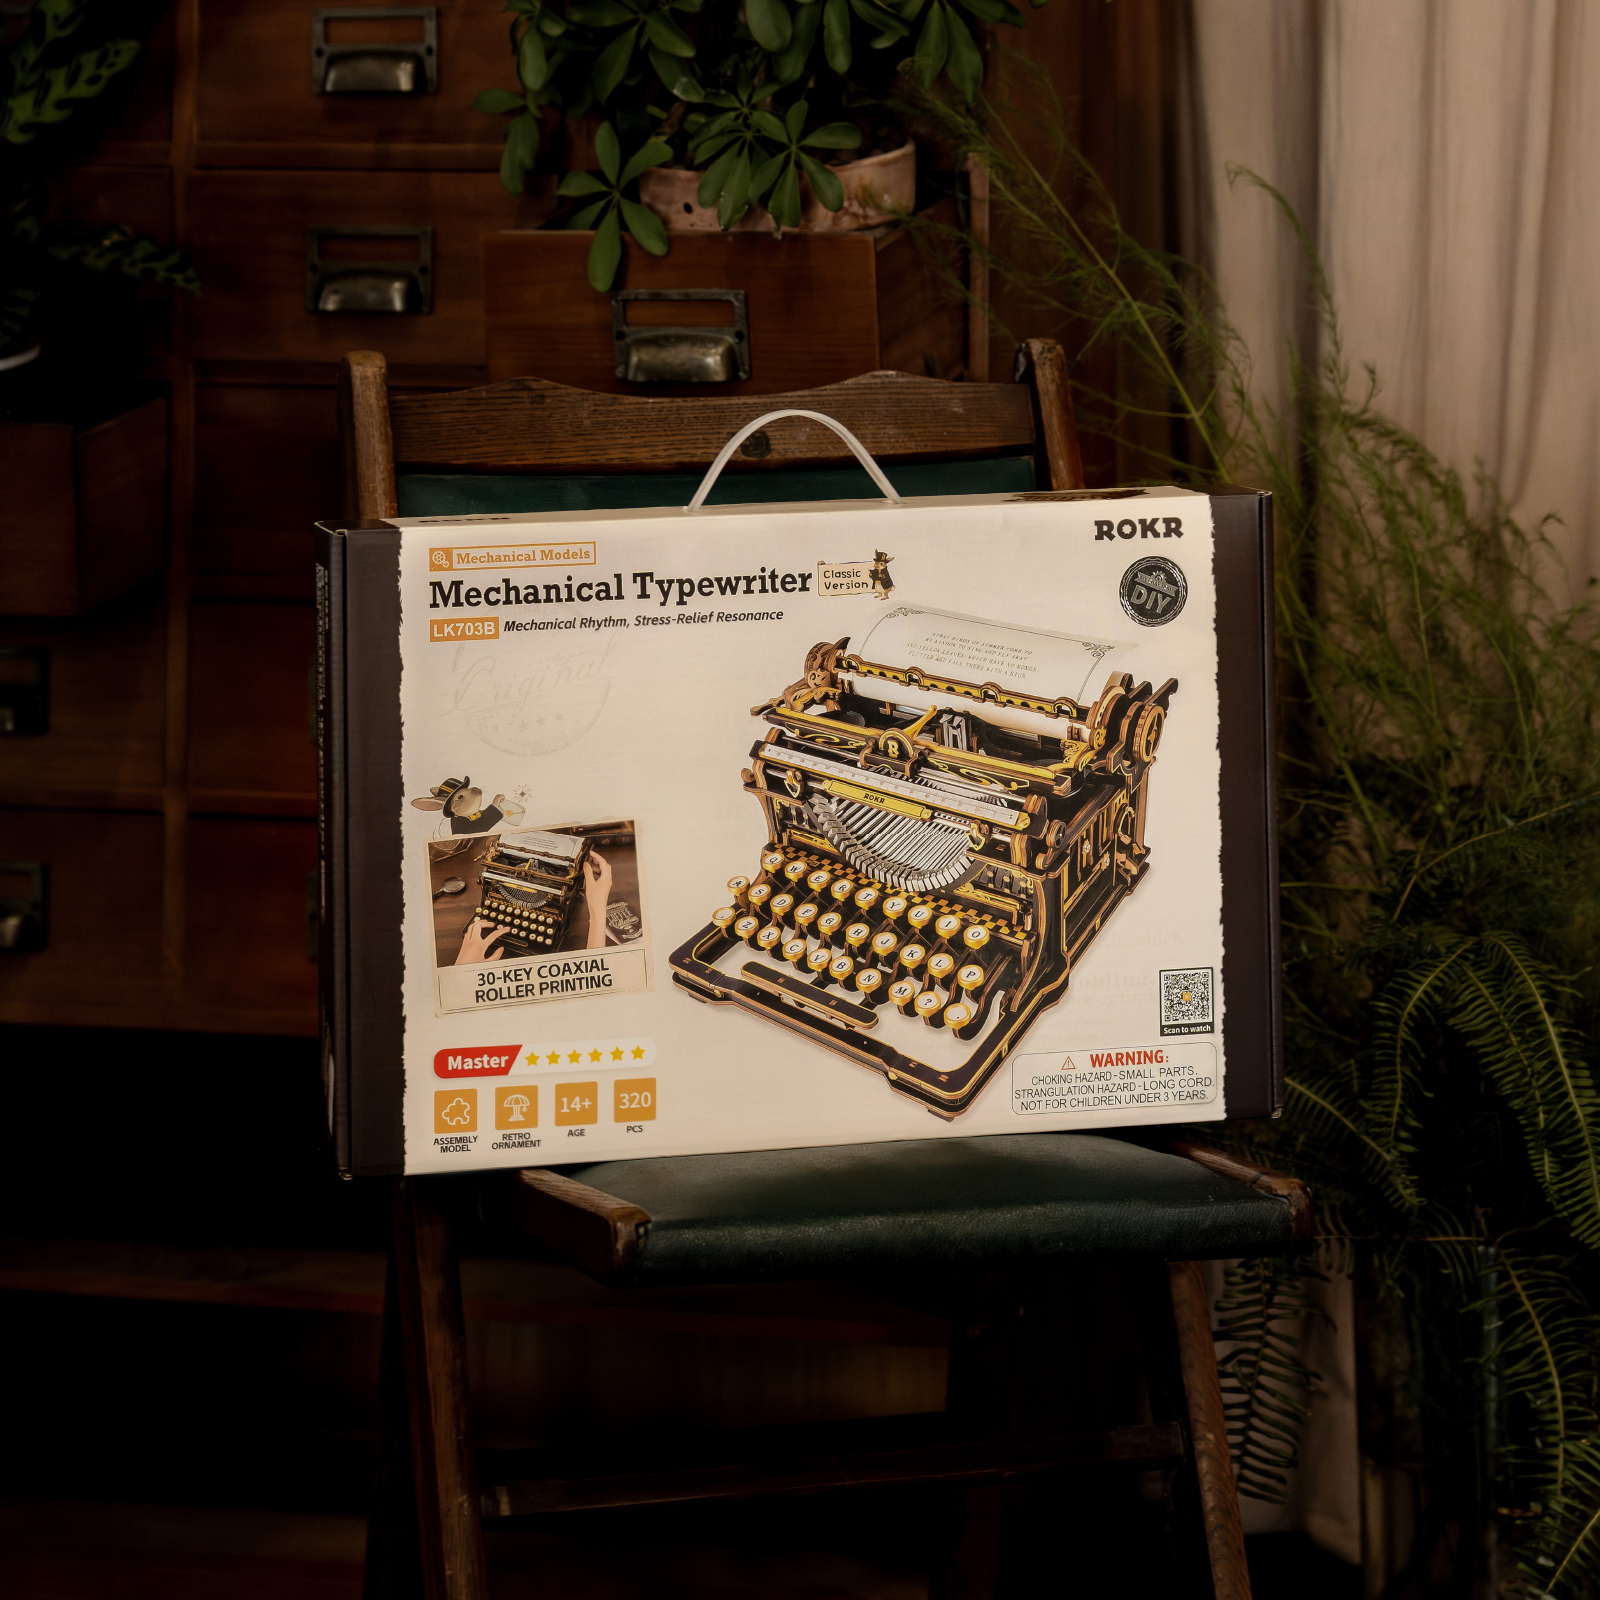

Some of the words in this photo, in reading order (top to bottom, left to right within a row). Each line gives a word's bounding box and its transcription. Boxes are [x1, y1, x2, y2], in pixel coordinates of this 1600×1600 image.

[1094, 516, 1184, 541] ROKR
[456, 551, 537, 564] Mechanical
[540, 548, 591, 561] Models
[823, 568, 861, 579] Classic
[429, 573, 625, 609] Mechanical
[632, 566, 813, 607] Typewriter
[824, 580, 869, 590] Version
[1130, 584, 1173, 614] DIY
[503, 617, 576, 632] Mechanical
[579, 615, 631, 632] Rhythm,
[634, 611, 714, 627] Stress-Relief
[716, 610, 784, 623] Resonance
[433, 621, 496, 638] LK703B
[888, 741, 899, 757] R
[863, 793, 886, 805] ROKR
[477, 967, 533, 987] 30-KEY
[537, 958, 609, 979] COAXIAL
[475, 982, 535, 1004] ROLLER
[539, 973, 613, 996] PRINTING
[1190, 1024, 1211, 1033] watch
[447, 1053, 509, 1071] Master
[1090, 1049, 1169, 1069] WARNING:
[1031, 1073, 1073, 1086] CHOKING
[1159, 1065, 1198, 1077] PARTS.
[1014, 1084, 1095, 1099] STRANGULATION
[1178, 1076, 1215, 1089] CORD.
[560, 1096, 592, 1112] 14+
[619, 1092, 652, 1109] 320
[1021, 1100, 1043, 1111] NOT
[1045, 1098, 1067, 1110] FOR
[1069, 1094, 1121, 1108] CHILDREN
[1125, 1092, 1161, 1105] UNDER
[1163, 1091, 1170, 1102] 3
[1171, 1089, 1209, 1101] YEARS.
[502, 1132, 531, 1141] RETRO
[567, 1128, 586, 1137] AGE
[626, 1125, 644, 1133] PCS
[433, 1135, 478, 1146] ASSEMBLY
[440, 1144, 471, 1153] MODEL
[491, 1139, 541, 1150] ORNAMENT
